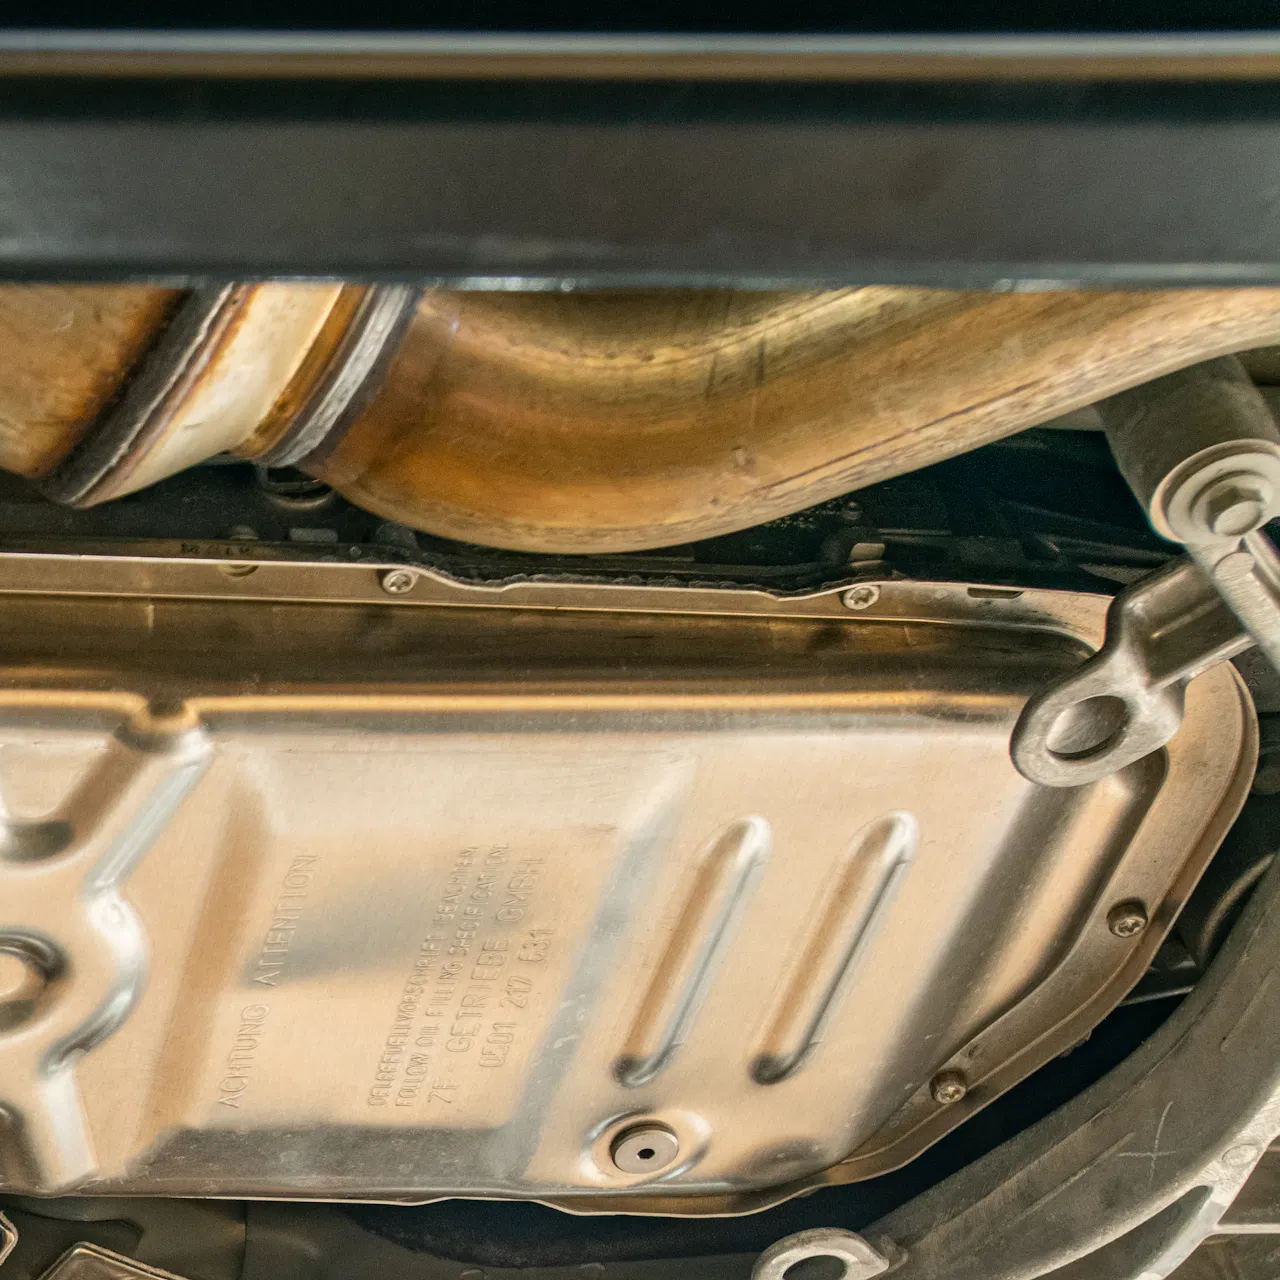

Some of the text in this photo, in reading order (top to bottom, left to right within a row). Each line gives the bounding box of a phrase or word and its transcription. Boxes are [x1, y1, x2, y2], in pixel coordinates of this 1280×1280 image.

[216, 853, 320, 1109] ACHTUNG ATTENTION
[424, 961, 464, 1017] FILLING
[445, 939, 510, 1053] GETRIEBE
[496, 857, 545, 922] GMBH
[478, 927, 554, 1068] 0501 217 631
[395, 1052, 430, 1108] FOLLOW
[415, 1023, 445, 1047] OIL
